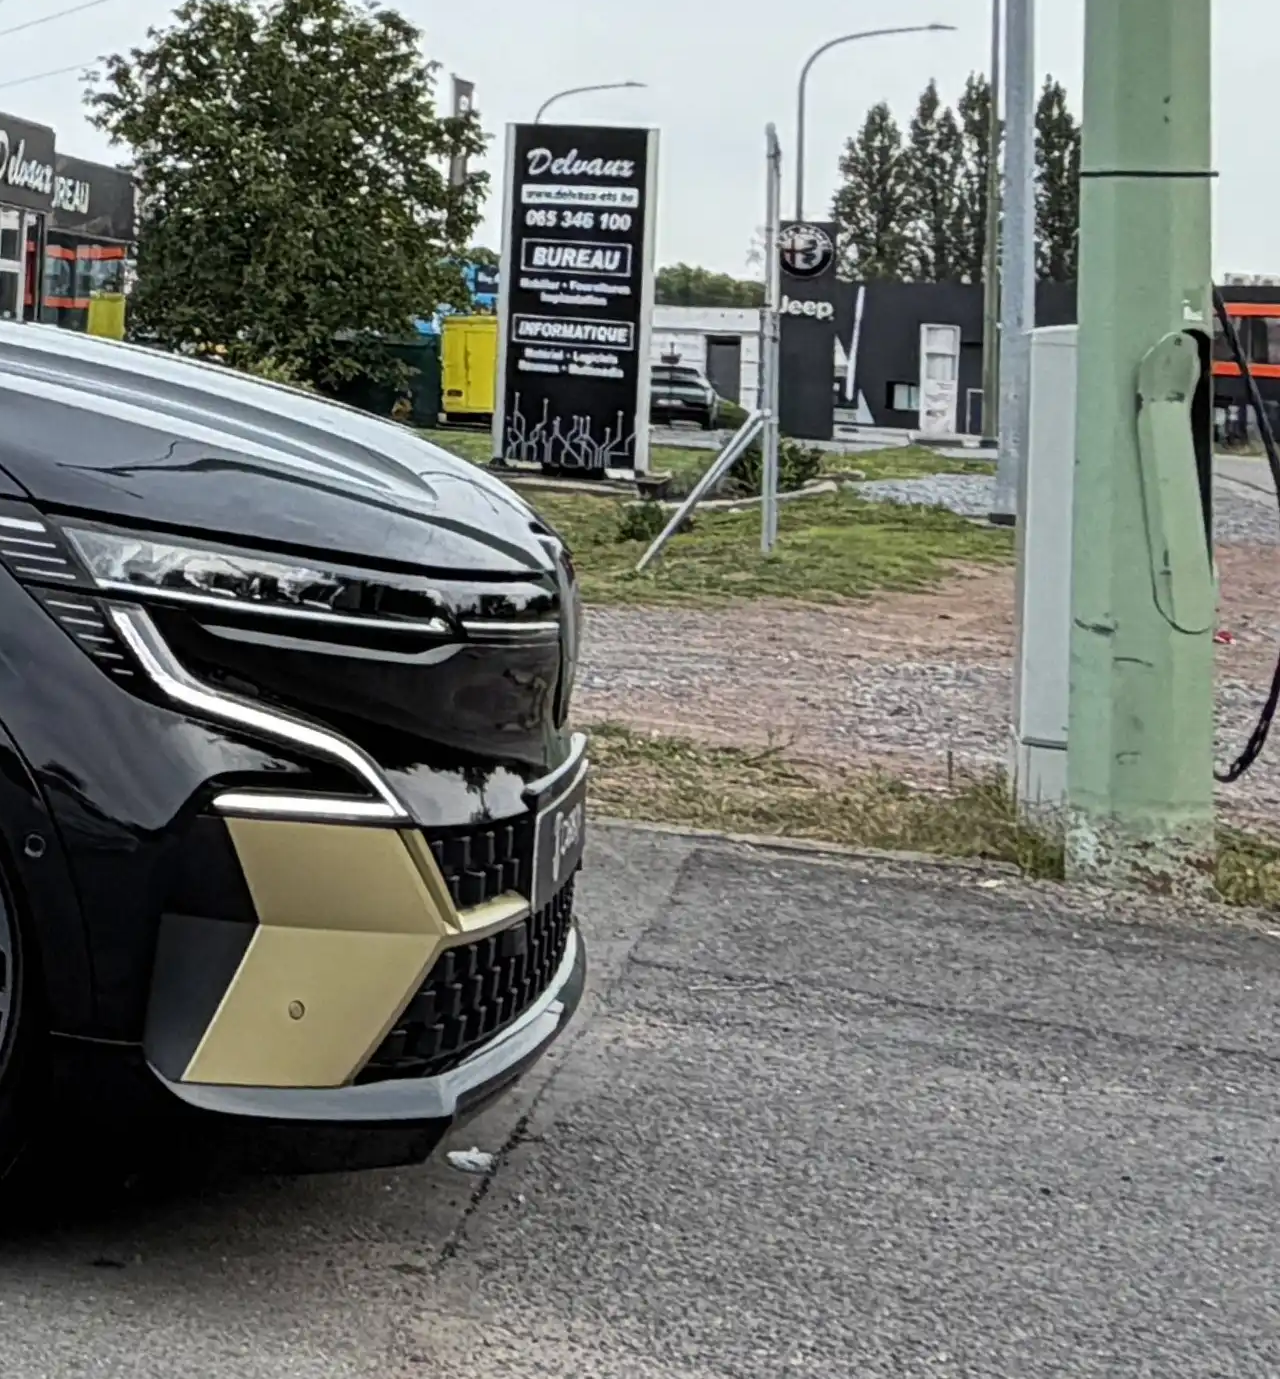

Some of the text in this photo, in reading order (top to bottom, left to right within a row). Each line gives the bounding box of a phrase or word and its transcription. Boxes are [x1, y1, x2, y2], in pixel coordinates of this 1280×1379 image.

[526, 147, 636, 178] Delvaux
[51, 175, 90, 215] REAU
[599, 212, 632, 232] 100
[532, 246, 622, 271] BUREAU
[780, 294, 834, 320] Jeep
[518, 321, 629, 343] INFORMATIQUE
